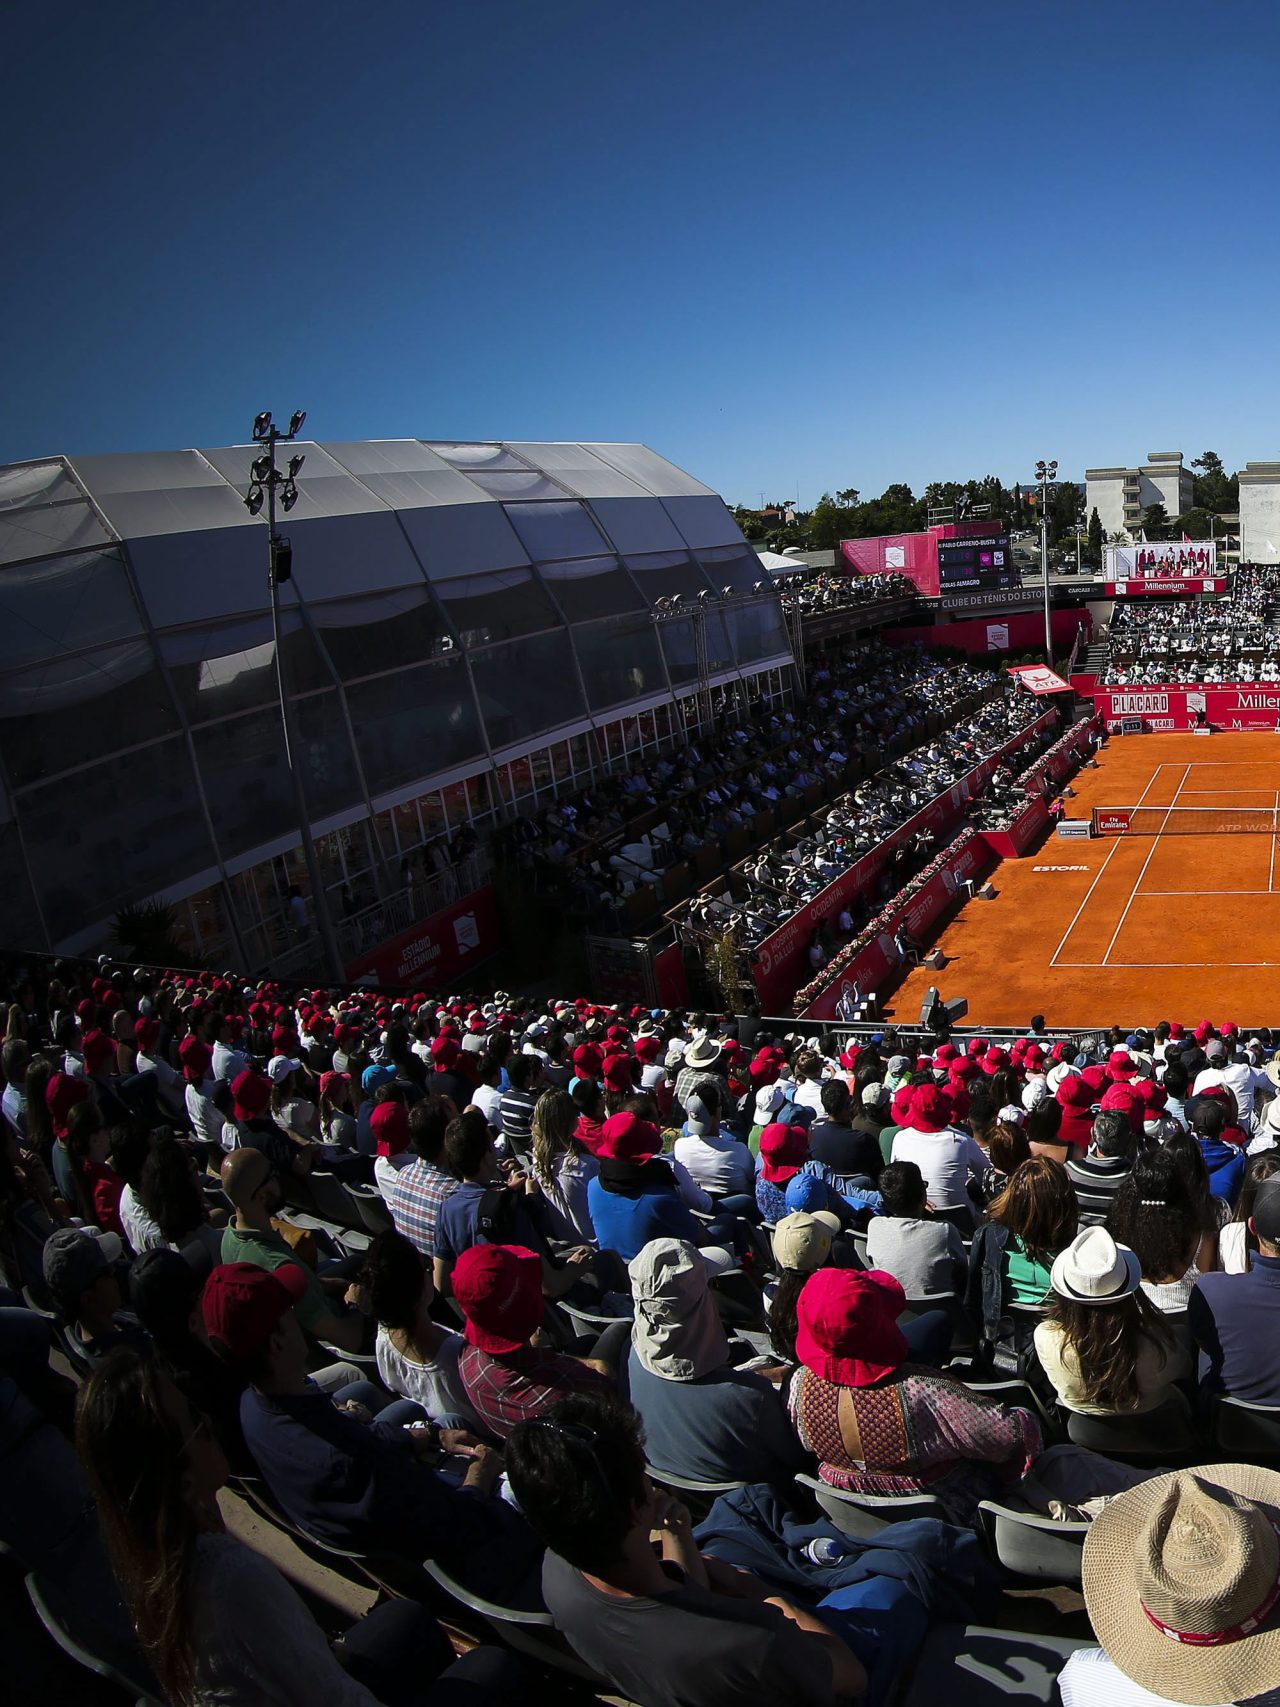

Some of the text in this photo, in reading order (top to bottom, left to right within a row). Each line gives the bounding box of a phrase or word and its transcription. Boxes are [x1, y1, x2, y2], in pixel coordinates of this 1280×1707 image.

[956, 579, 980, 587] ALMAGRO
[1144, 581, 1185, 590] Millennium
[942, 599, 969, 608] CLUBE
[970, 597, 982, 605] DE
[983, 593, 1006, 604] TÉNIS
[1007, 593, 1021, 601] DO
[1113, 695, 1168, 712] PLACARD
[1232, 718, 1242, 728] M
[1100, 821, 1128, 829] Emirates
[1216, 824, 1242, 832] ATP
[810, 886, 845, 921] OCIDENTAL
[919, 894, 934, 917] RTP
[770, 923, 799, 953] HOSPITAL
[402, 935, 431, 962] ESTÁDIO
[398, 944, 441, 978] MILLENNIUM
